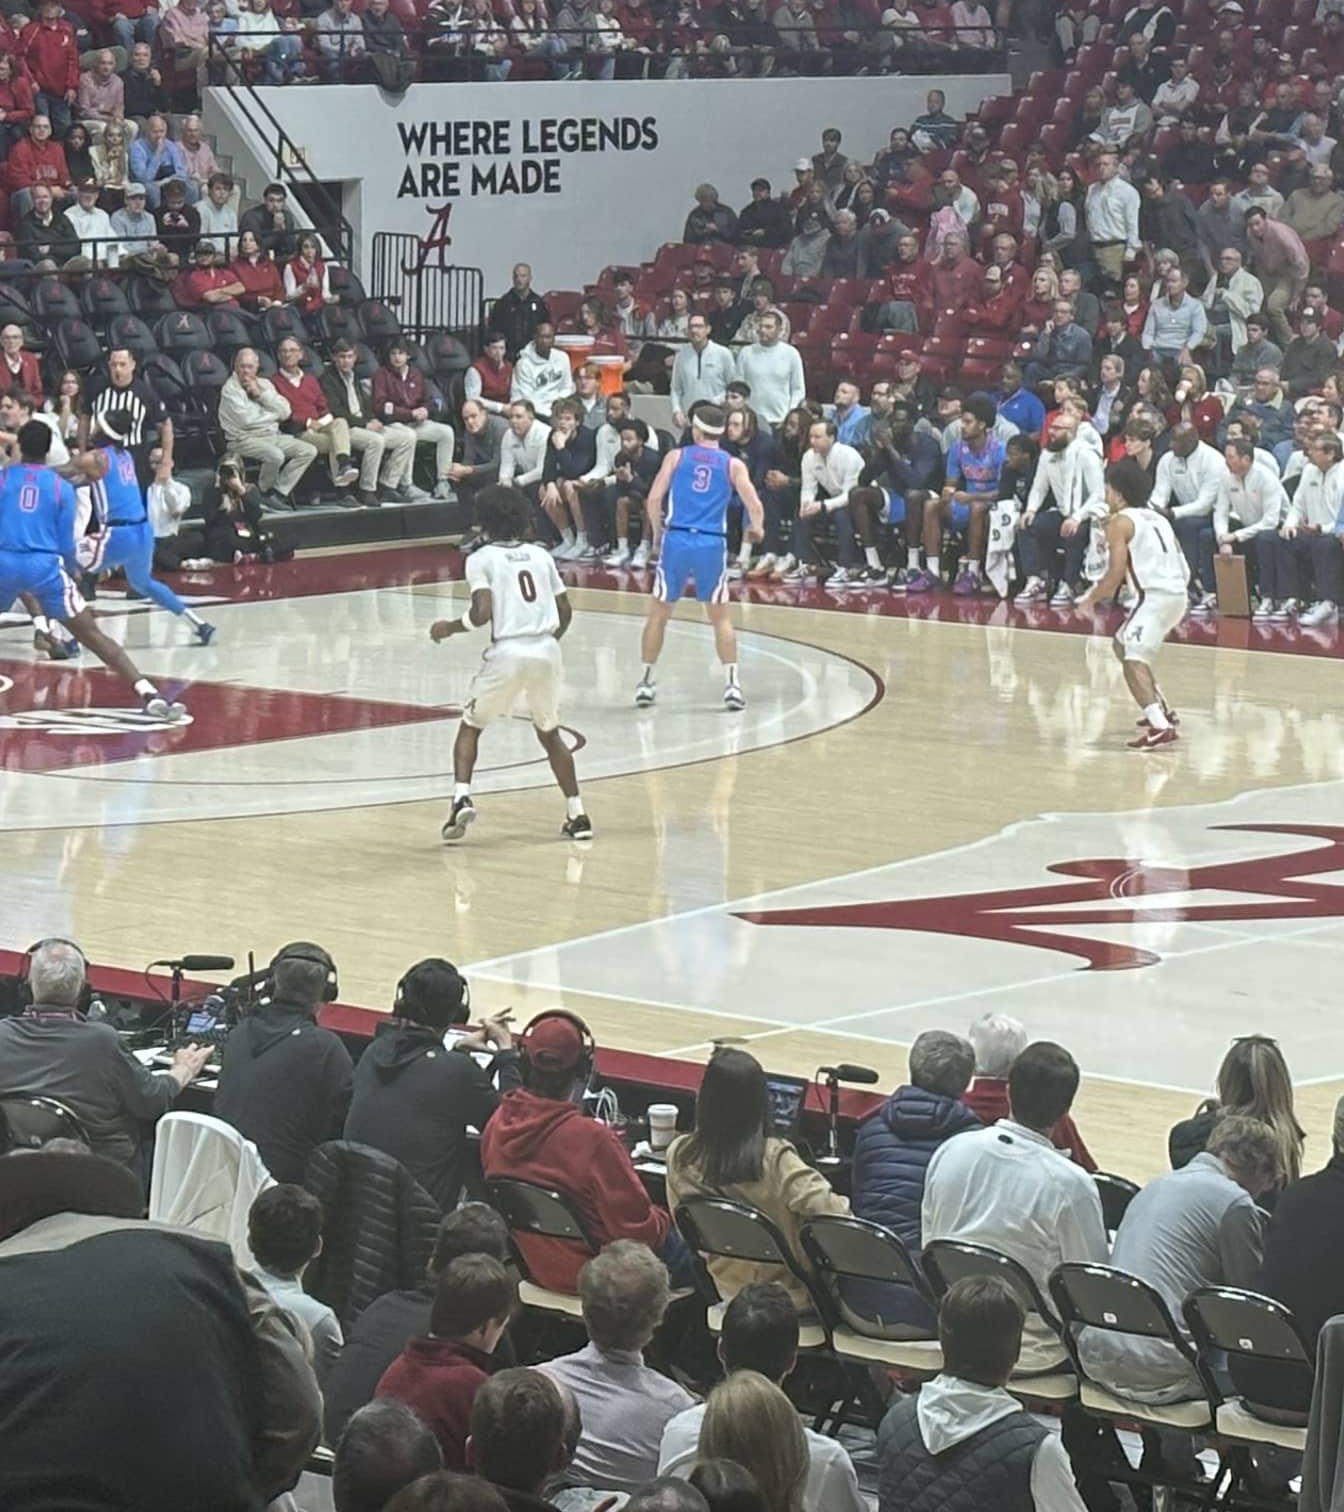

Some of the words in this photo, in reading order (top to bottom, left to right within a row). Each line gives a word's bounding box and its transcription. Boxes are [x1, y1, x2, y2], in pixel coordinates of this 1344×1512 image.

[397, 120, 510, 156] WHERE
[522, 117, 659, 153] LEGENDS
[397, 162, 460, 198] ARE
[471, 159, 561, 196] MADE
[692, 465, 712, 492] 3
[20, 485, 39, 512] 0
[1153, 526, 1167, 554] 1
[517, 569, 537, 603] 0
